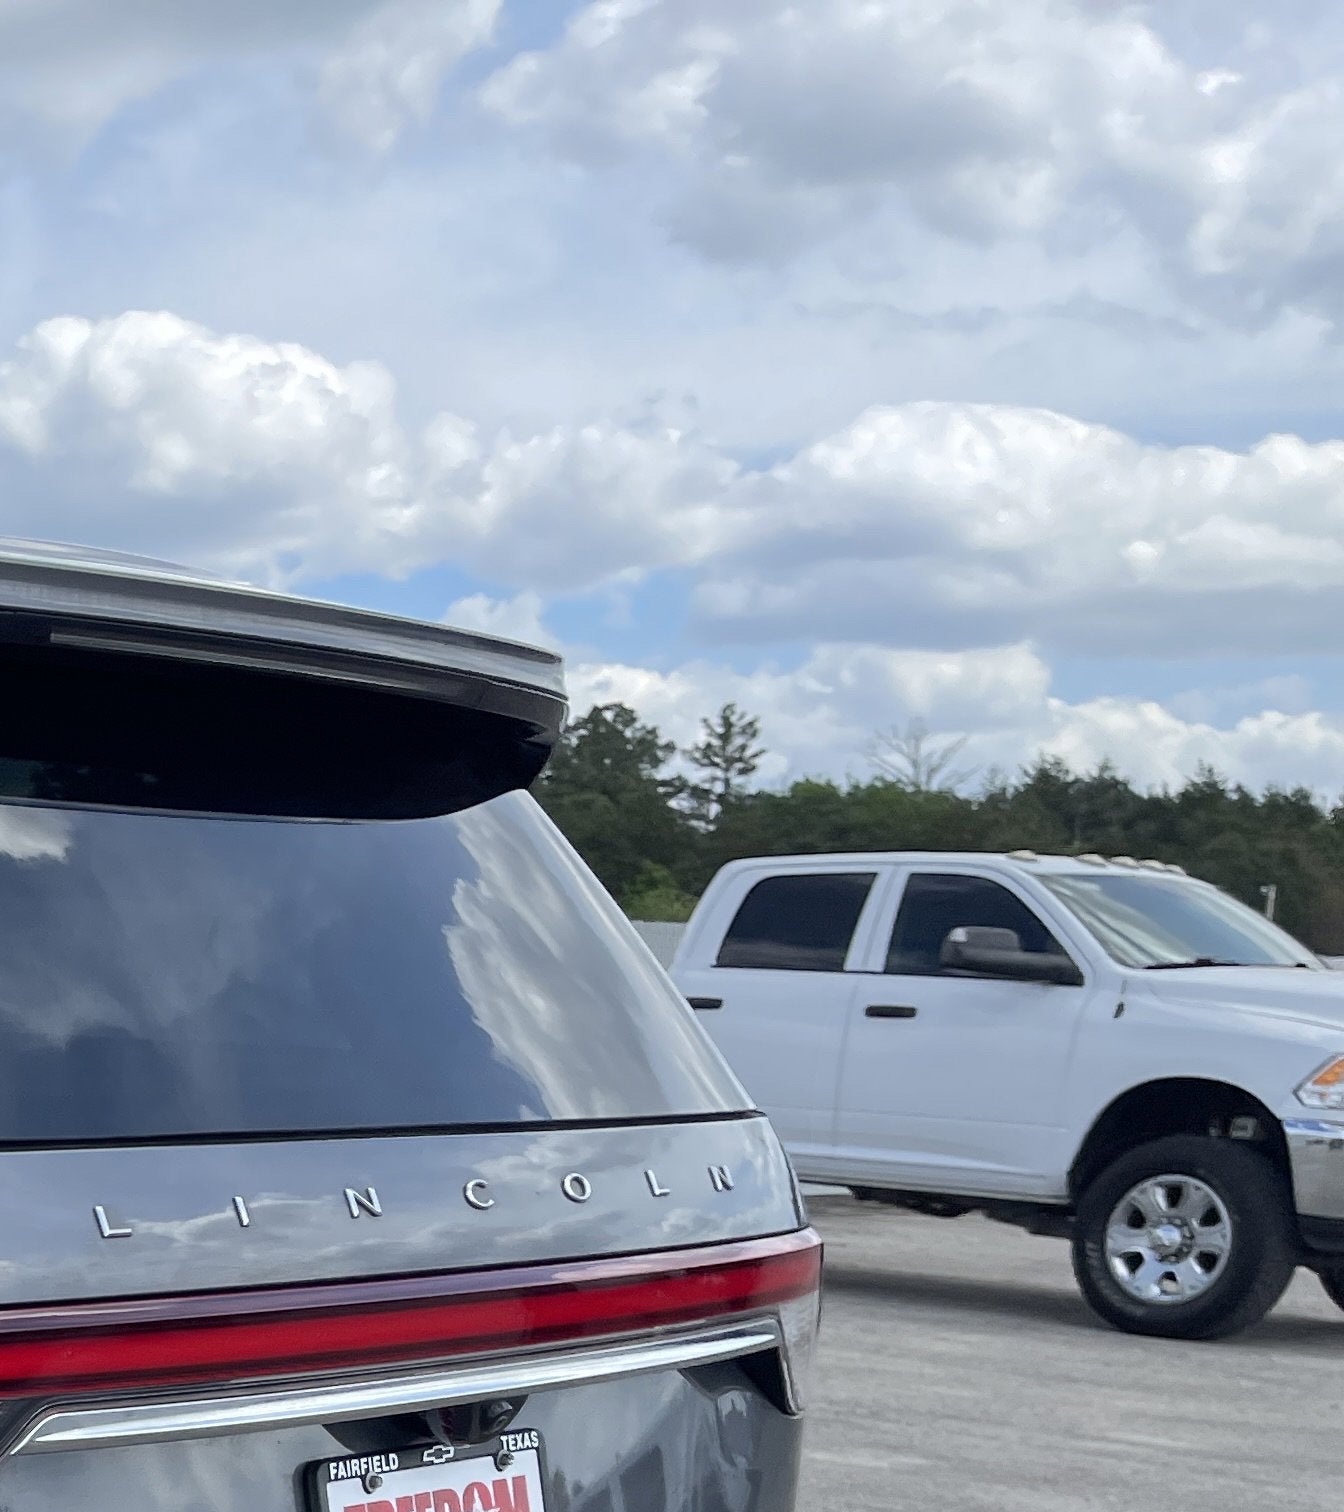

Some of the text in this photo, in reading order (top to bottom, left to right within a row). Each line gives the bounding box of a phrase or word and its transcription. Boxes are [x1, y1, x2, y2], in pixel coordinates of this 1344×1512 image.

[94, 1163, 736, 1240] LINCOLN
[328, 1431, 539, 1481] FAIRFIELD TEXAS
